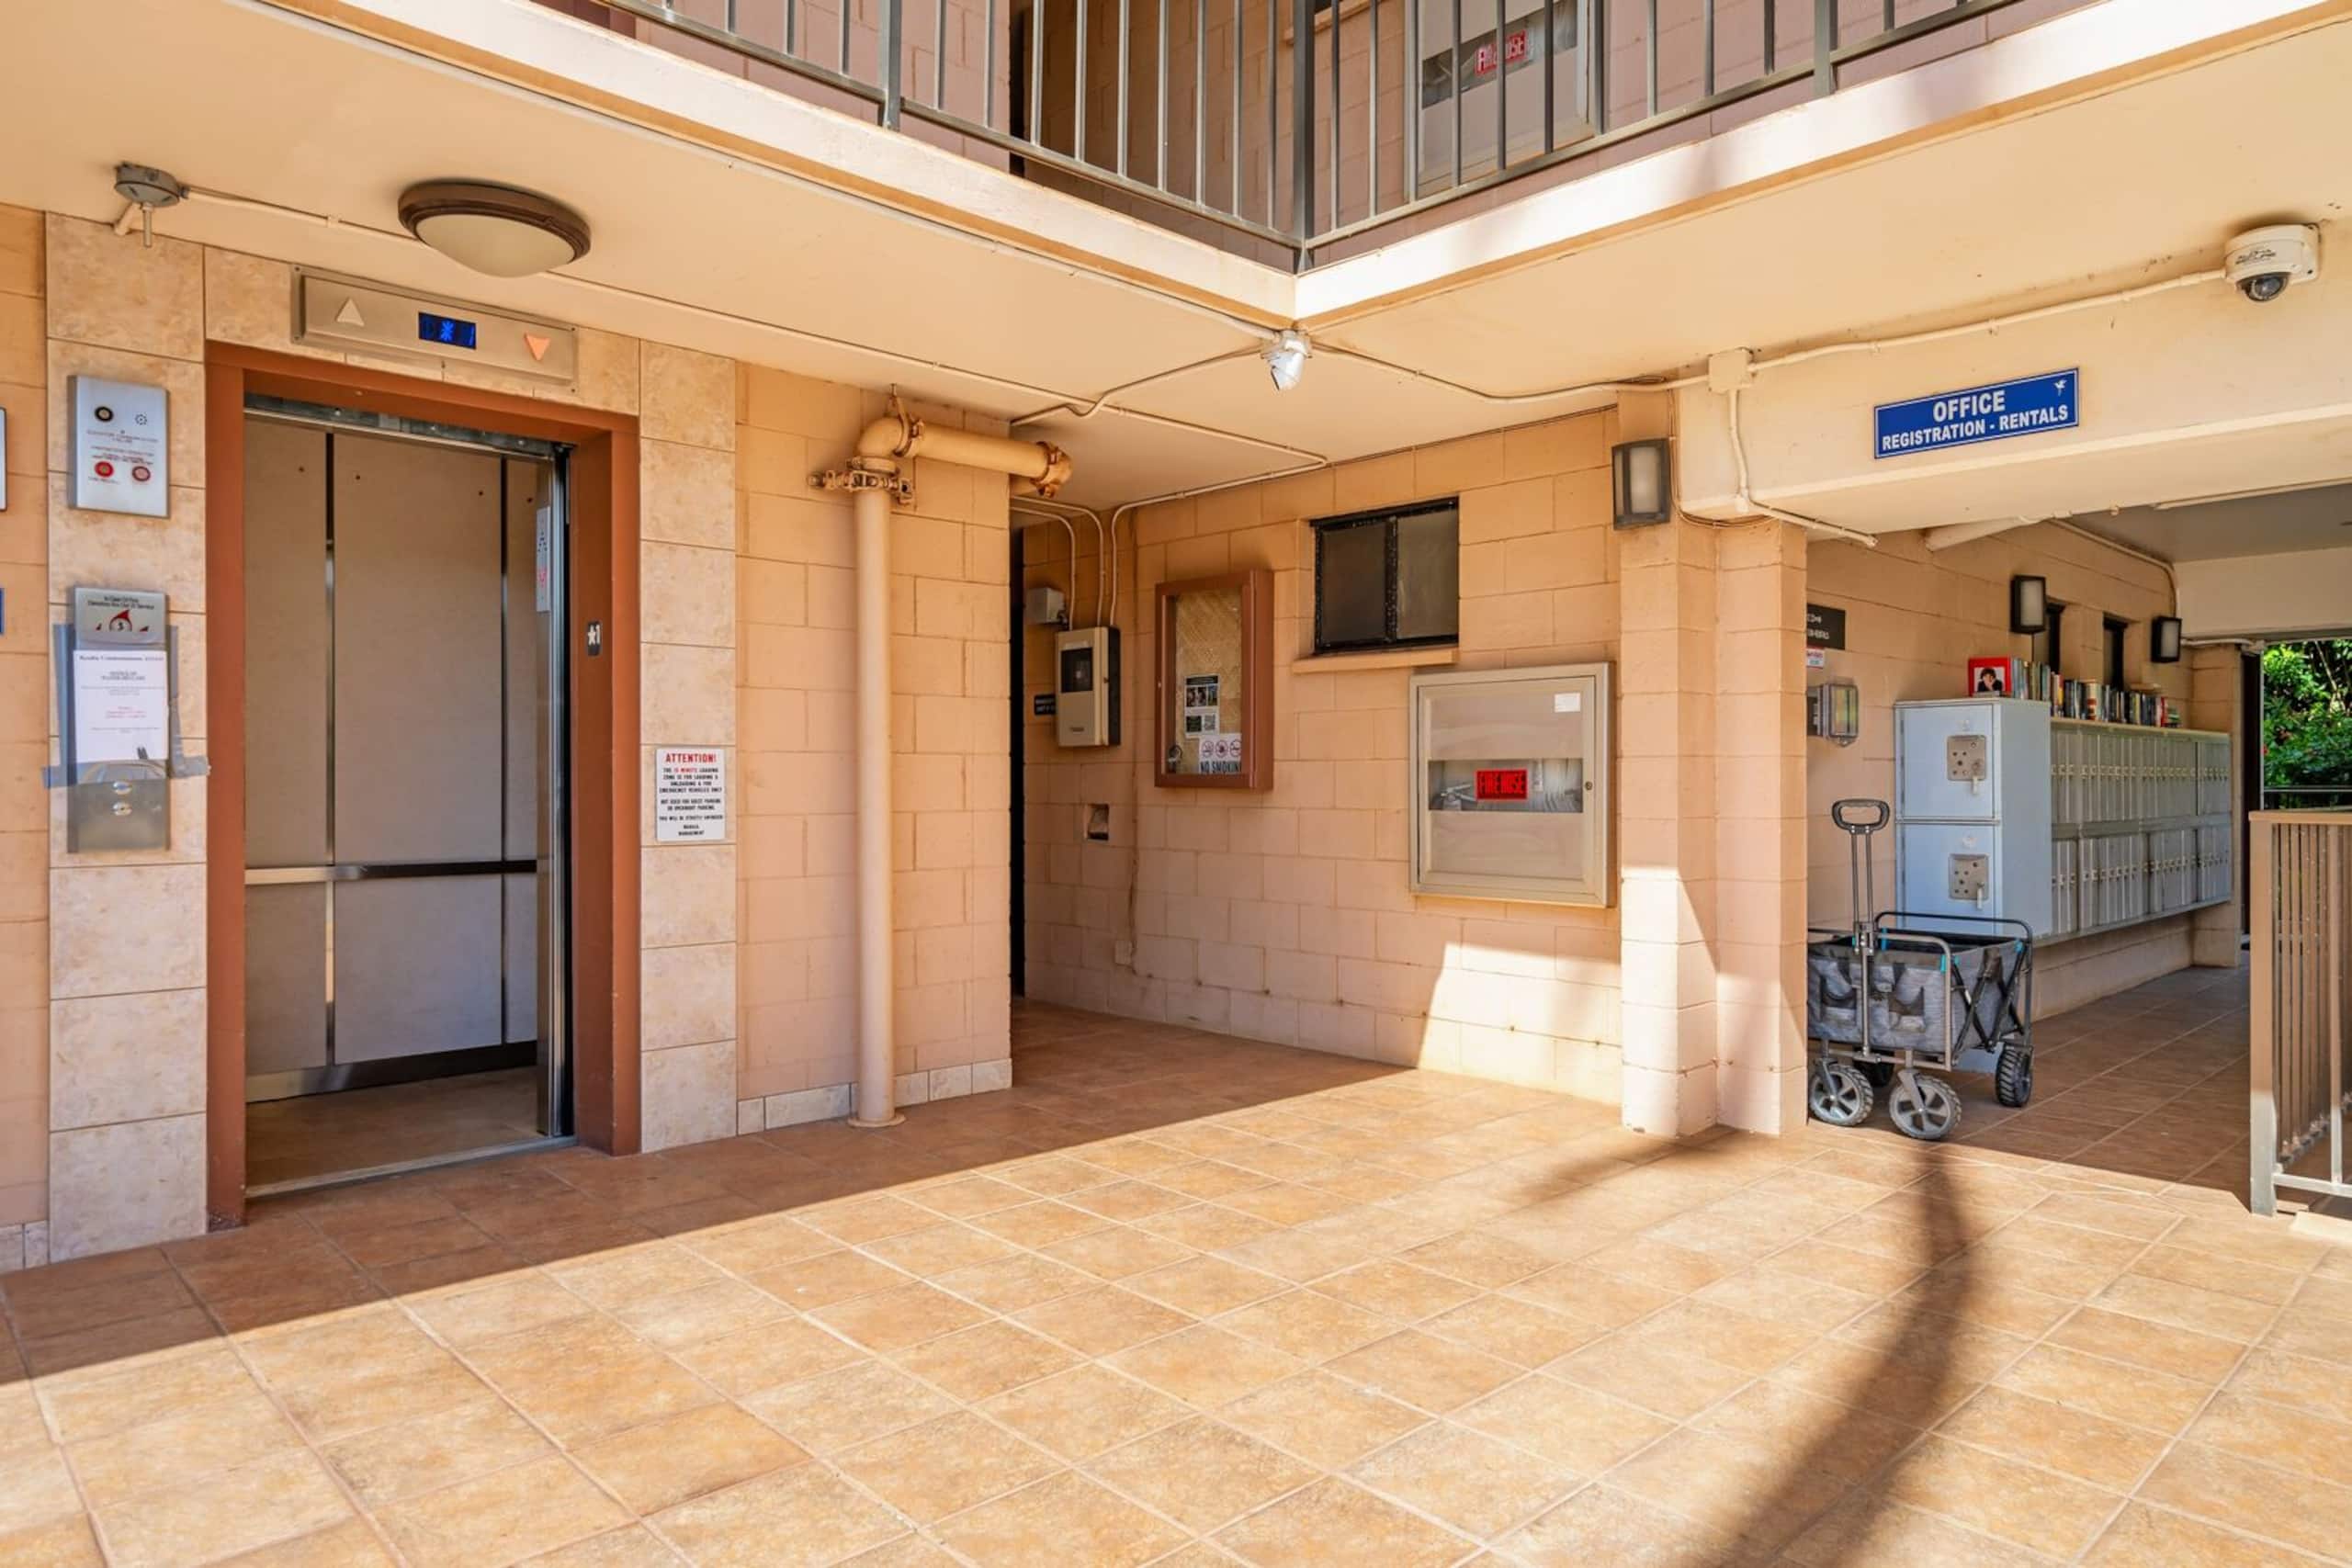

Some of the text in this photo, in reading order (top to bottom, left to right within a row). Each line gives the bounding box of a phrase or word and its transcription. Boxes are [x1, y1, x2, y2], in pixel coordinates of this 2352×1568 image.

[1933, 389, 2006, 423] OFFICE
[1883, 418, 1985, 450] REGISTRATION
[1999, 404, 2068, 431] RENTALS
[665, 753, 717, 763] ATTENTION!
[1200, 761, 1241, 773] NO SMOKIN
